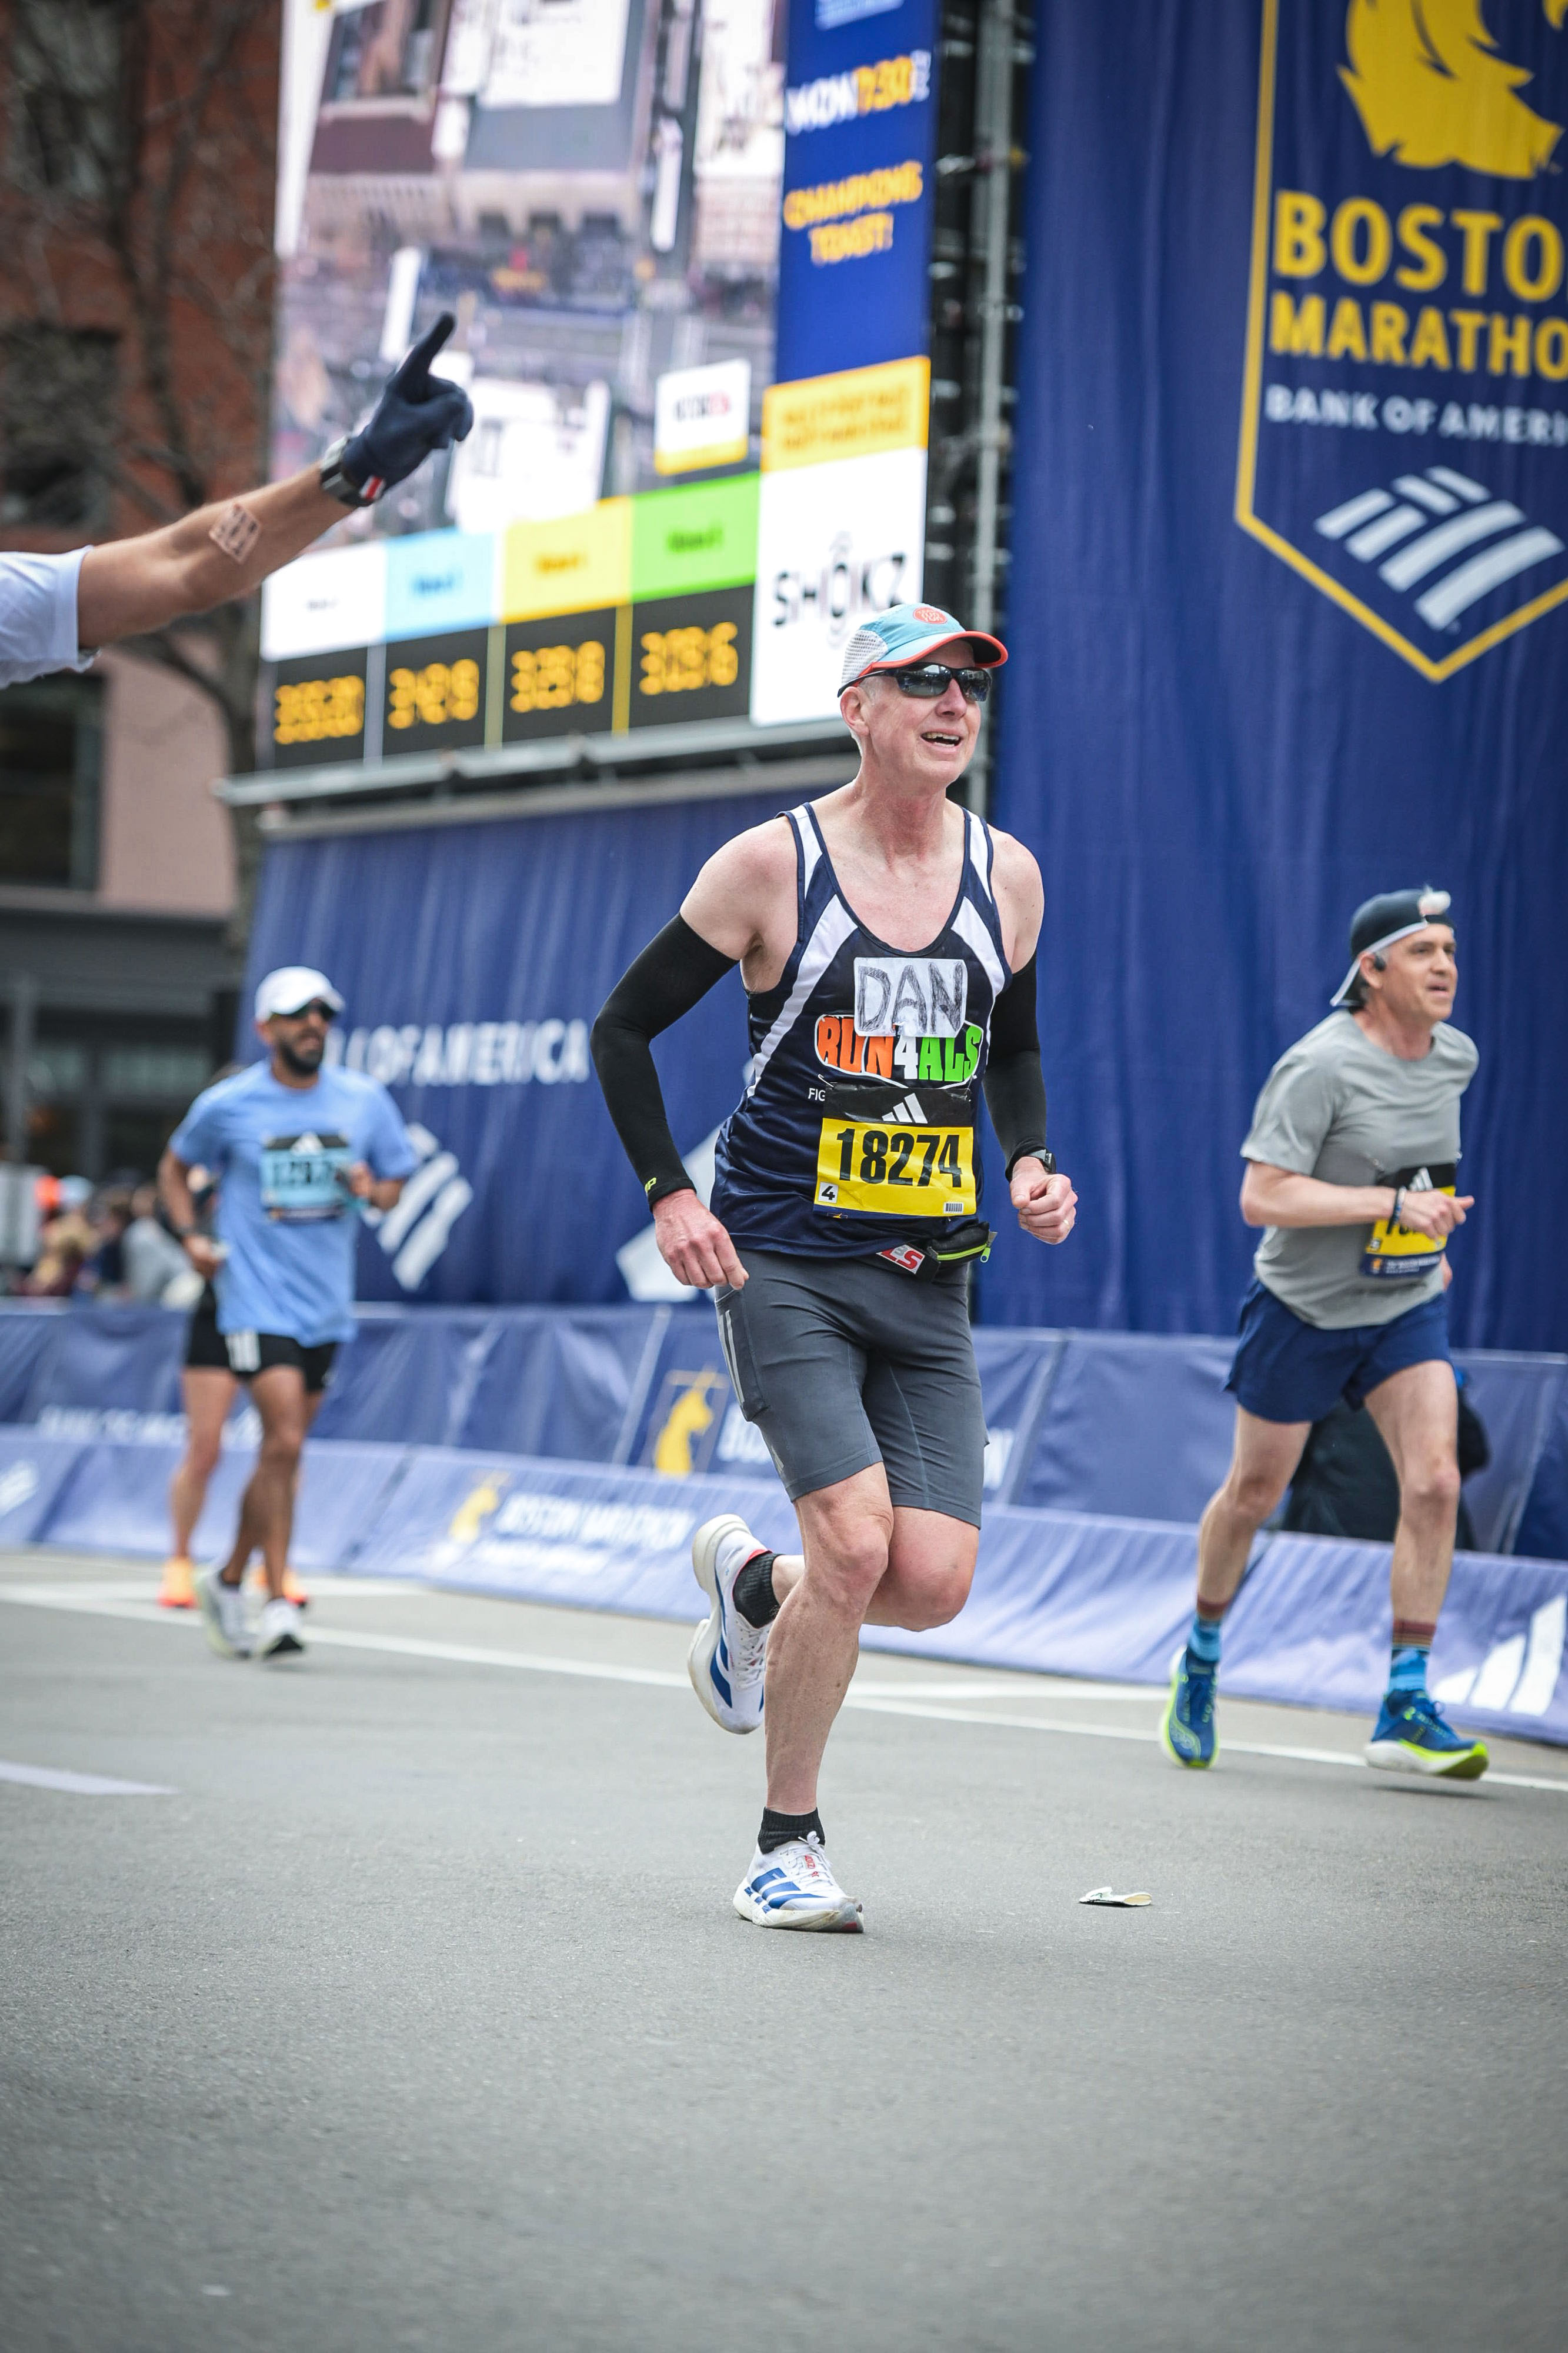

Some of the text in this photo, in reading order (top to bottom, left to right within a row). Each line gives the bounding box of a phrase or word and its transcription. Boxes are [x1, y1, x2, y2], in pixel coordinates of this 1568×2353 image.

[1273, 188, 1568, 302] BOSTO
[1269, 290, 1568, 381] MARATHO
[1265, 384, 1568, 447] BANK OF AMERI
[857, 961, 964, 1034] DAN
[412, 1019, 589, 1087] AMERICA
[808, 1088, 826, 1101] FIG
[836, 1128, 963, 1188] 18274
[821, 1185, 835, 1201] 4
